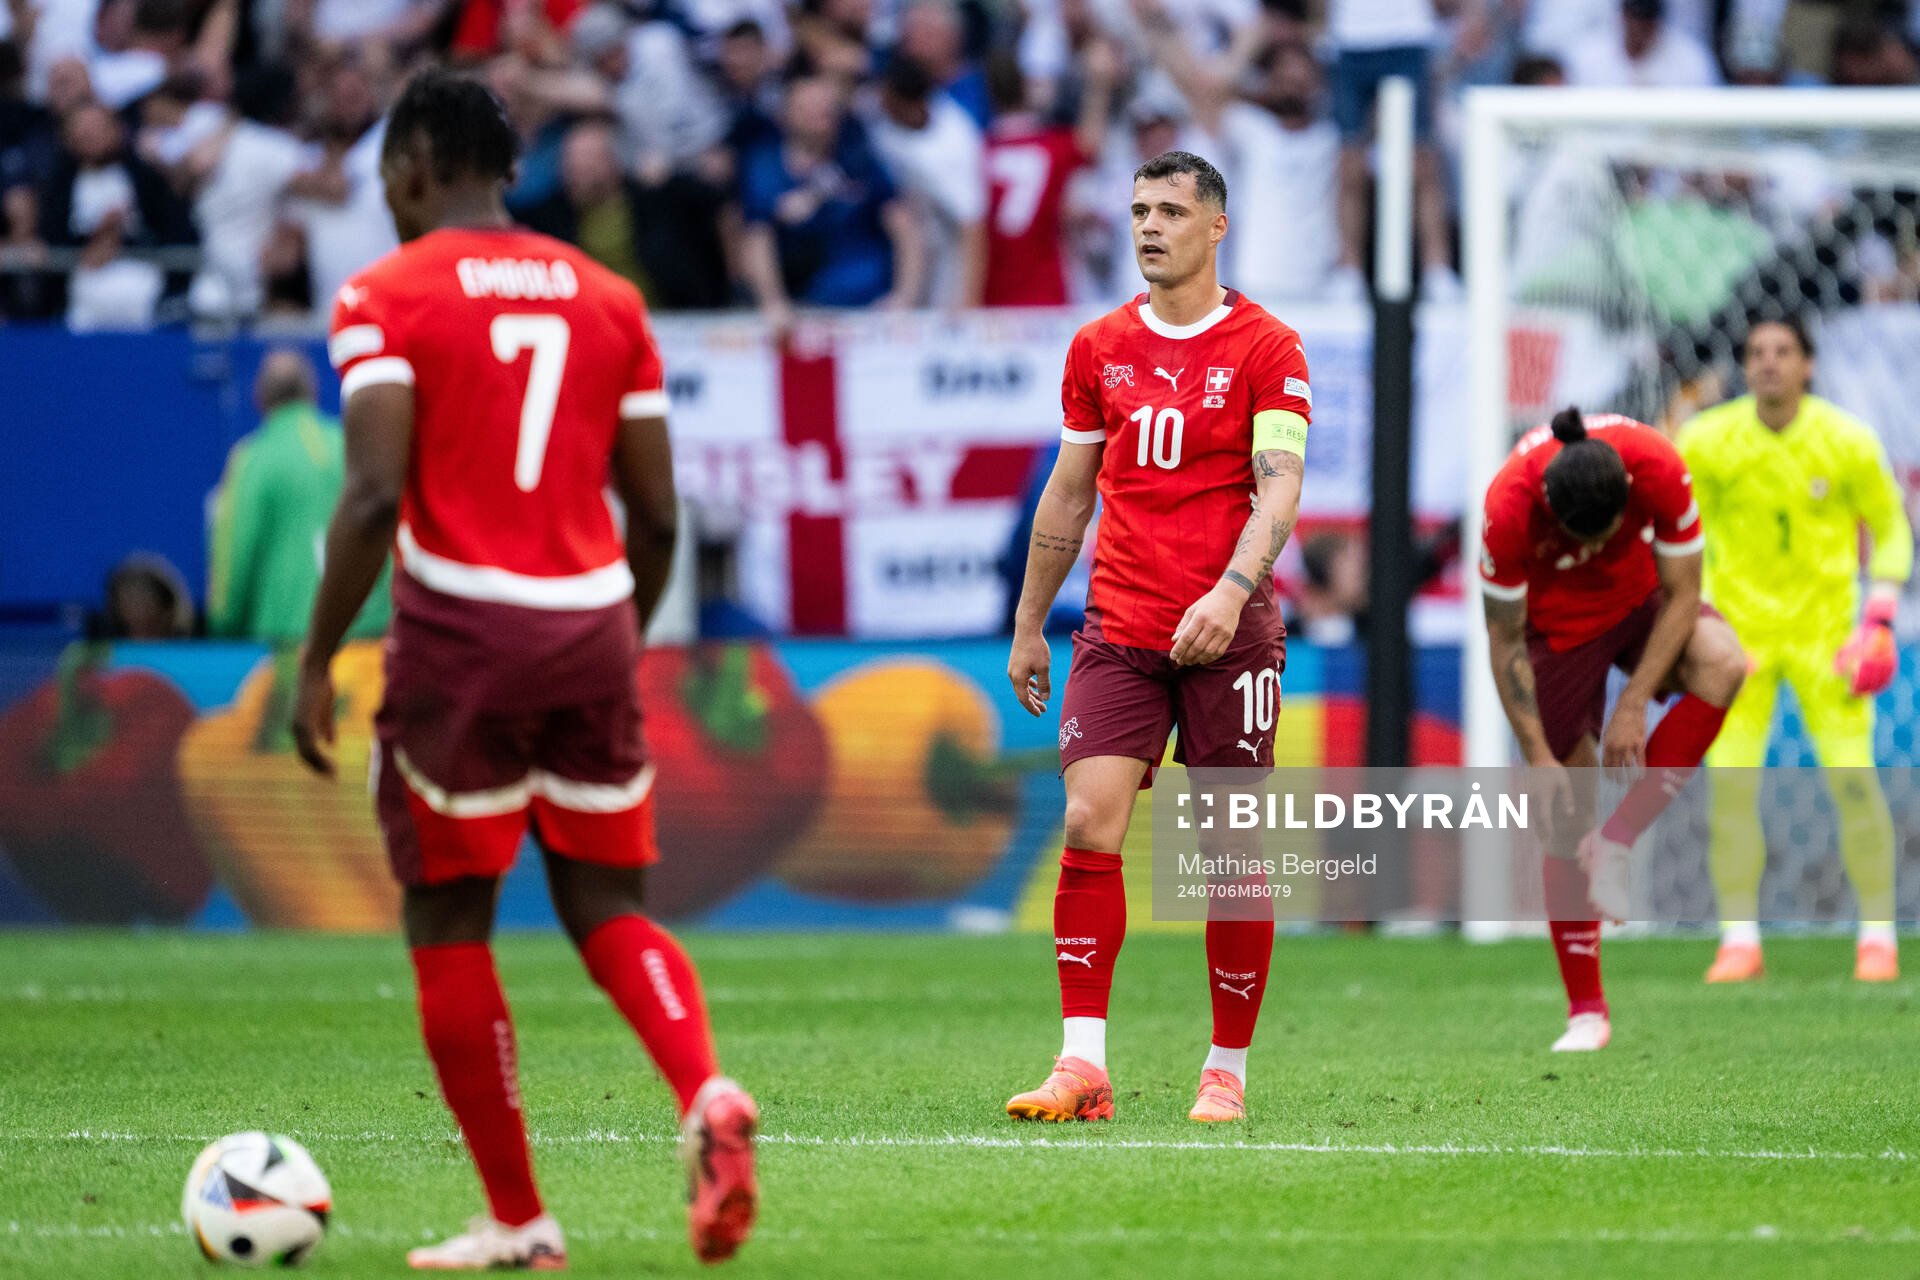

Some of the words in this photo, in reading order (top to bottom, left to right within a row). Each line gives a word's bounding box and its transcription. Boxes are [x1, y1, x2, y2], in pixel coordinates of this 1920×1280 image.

[989, 146, 1052, 237] 7
[456, 257, 579, 301] EMBOLO
[490, 314, 571, 493] 7
[1130, 405, 1185, 470] 10
[1775, 508, 1791, 553] 1
[1233, 668, 1275, 735] 10
[1055, 937, 1097, 945] SUISSE
[1215, 967, 1257, 980] SUISSE
